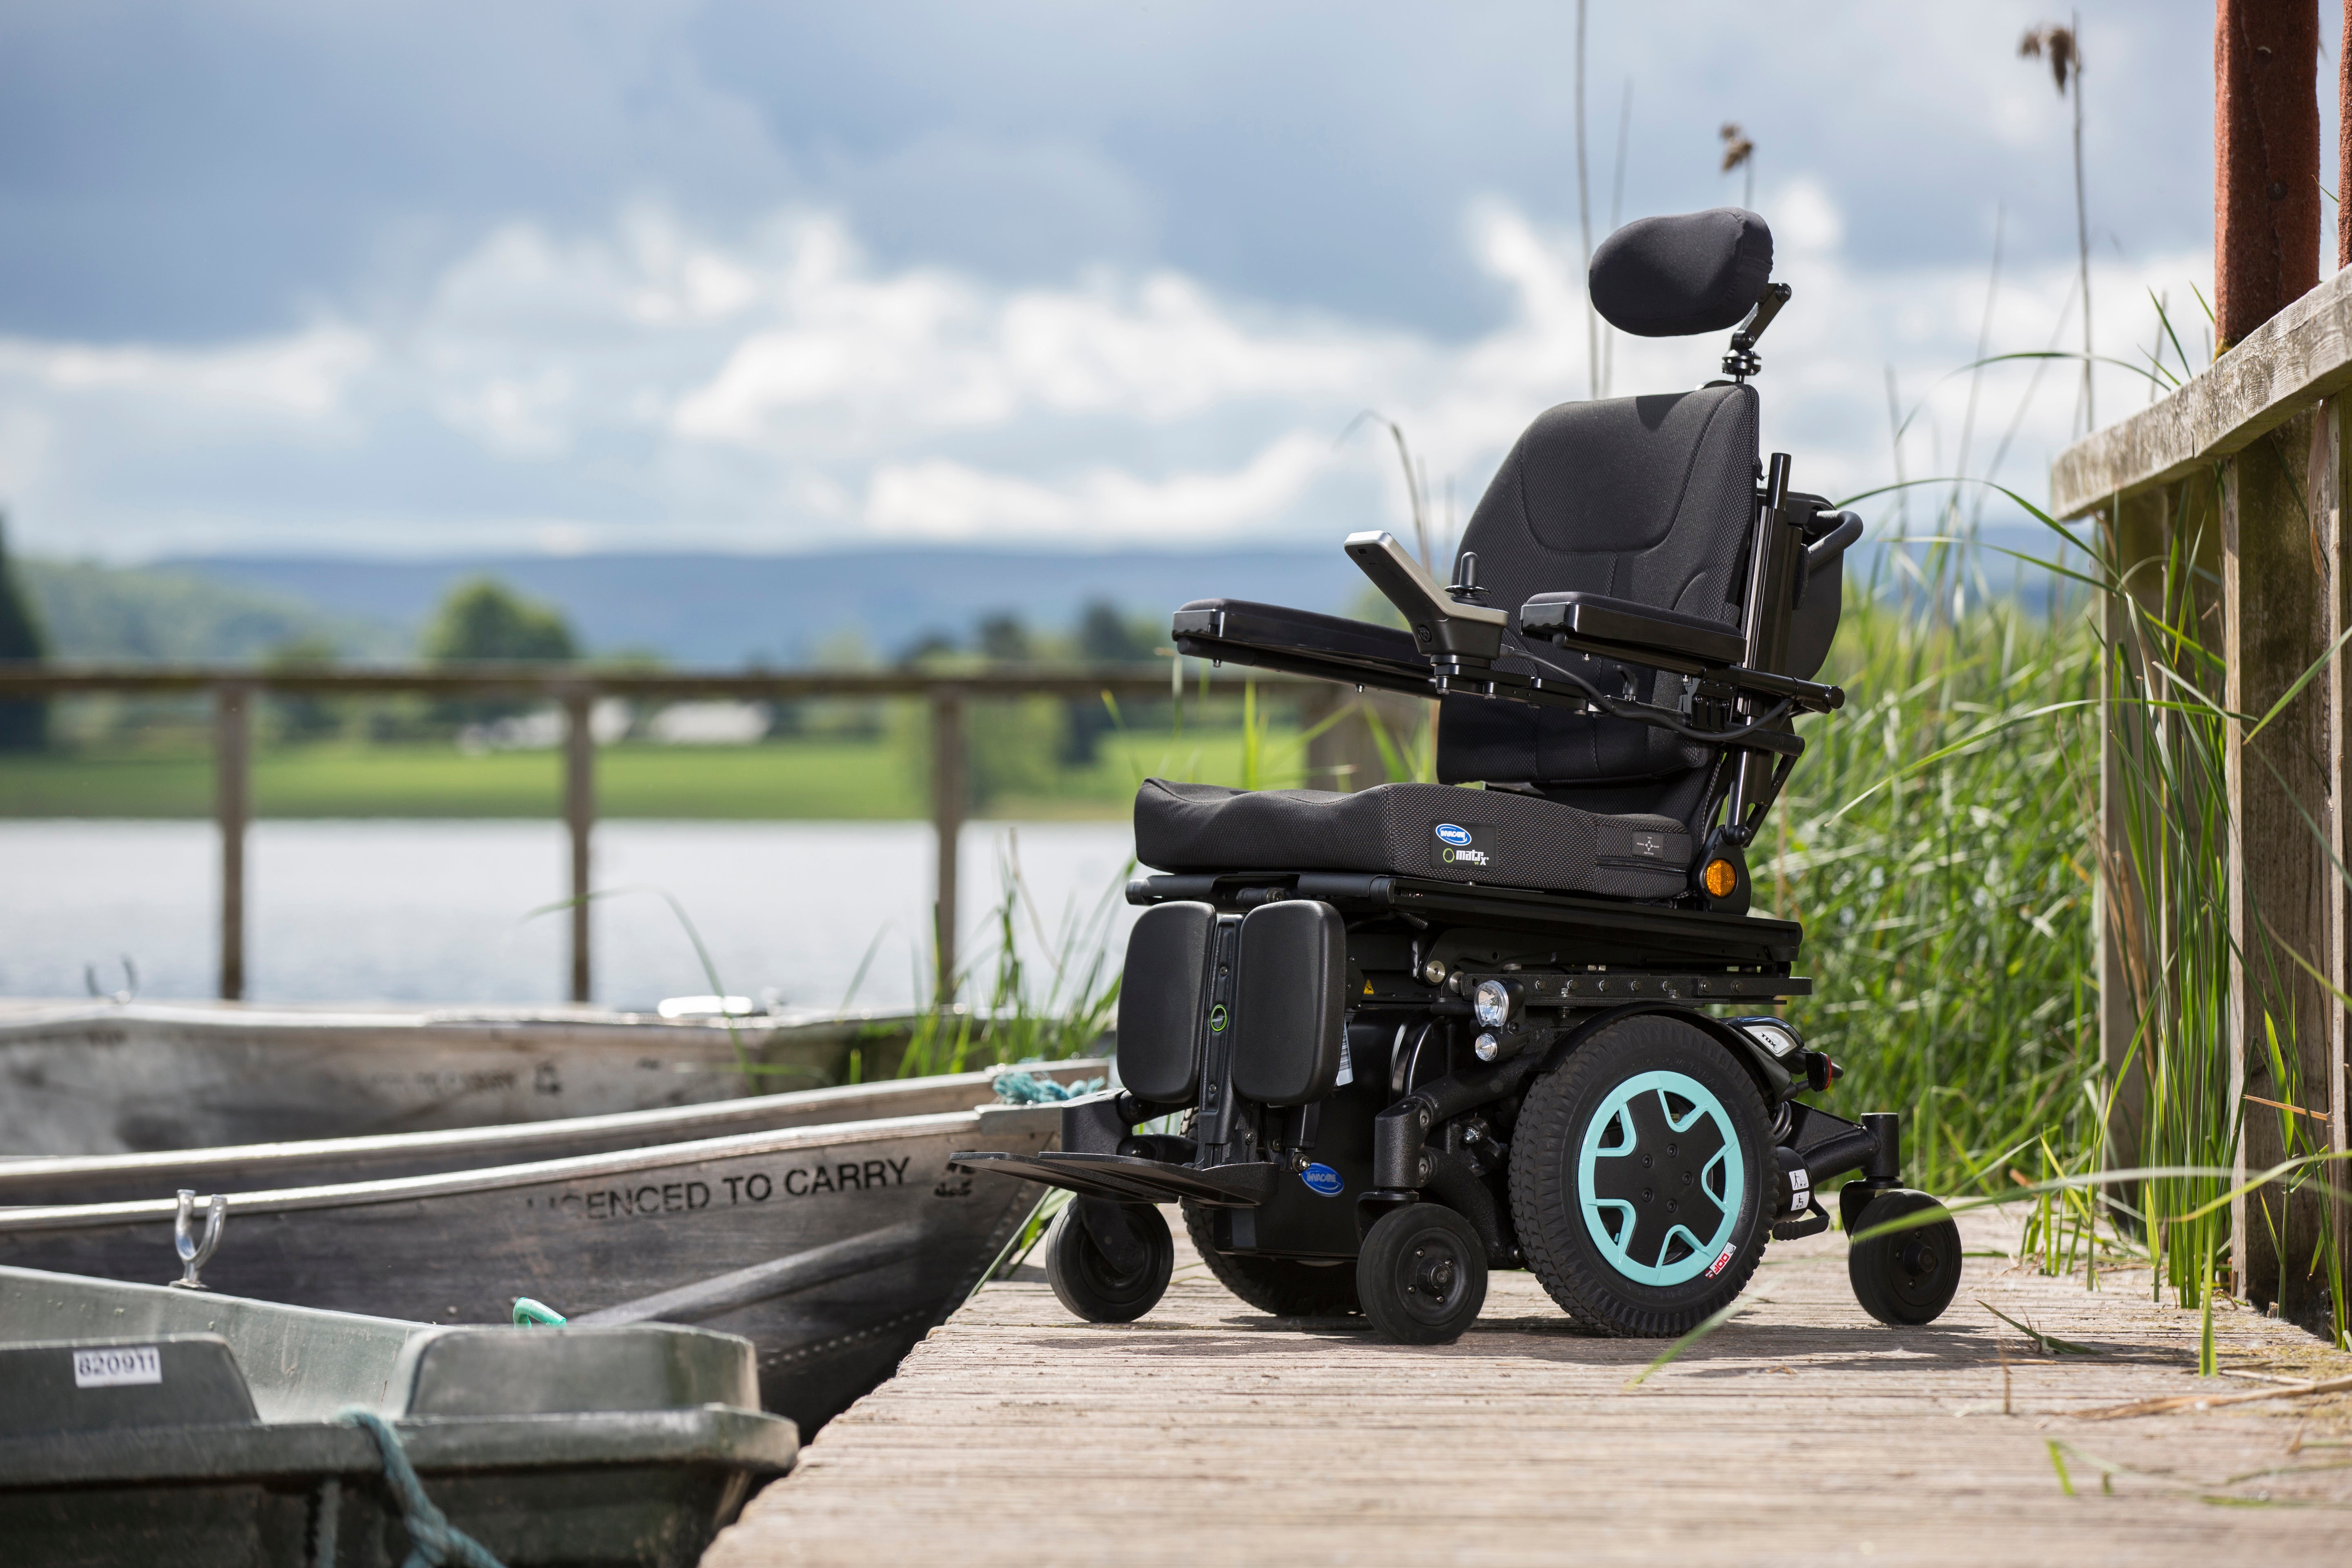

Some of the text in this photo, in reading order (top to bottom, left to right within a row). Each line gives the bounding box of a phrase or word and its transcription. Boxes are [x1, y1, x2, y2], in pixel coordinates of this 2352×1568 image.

[1761, 1032, 1777, 1048] TDX
[722, 1172, 773, 1205] TO
[785, 1156, 911, 1196] CARRY
[1307, 1172, 1336, 1183] INVACARE
[79, 1353, 155, 1376] 820911
